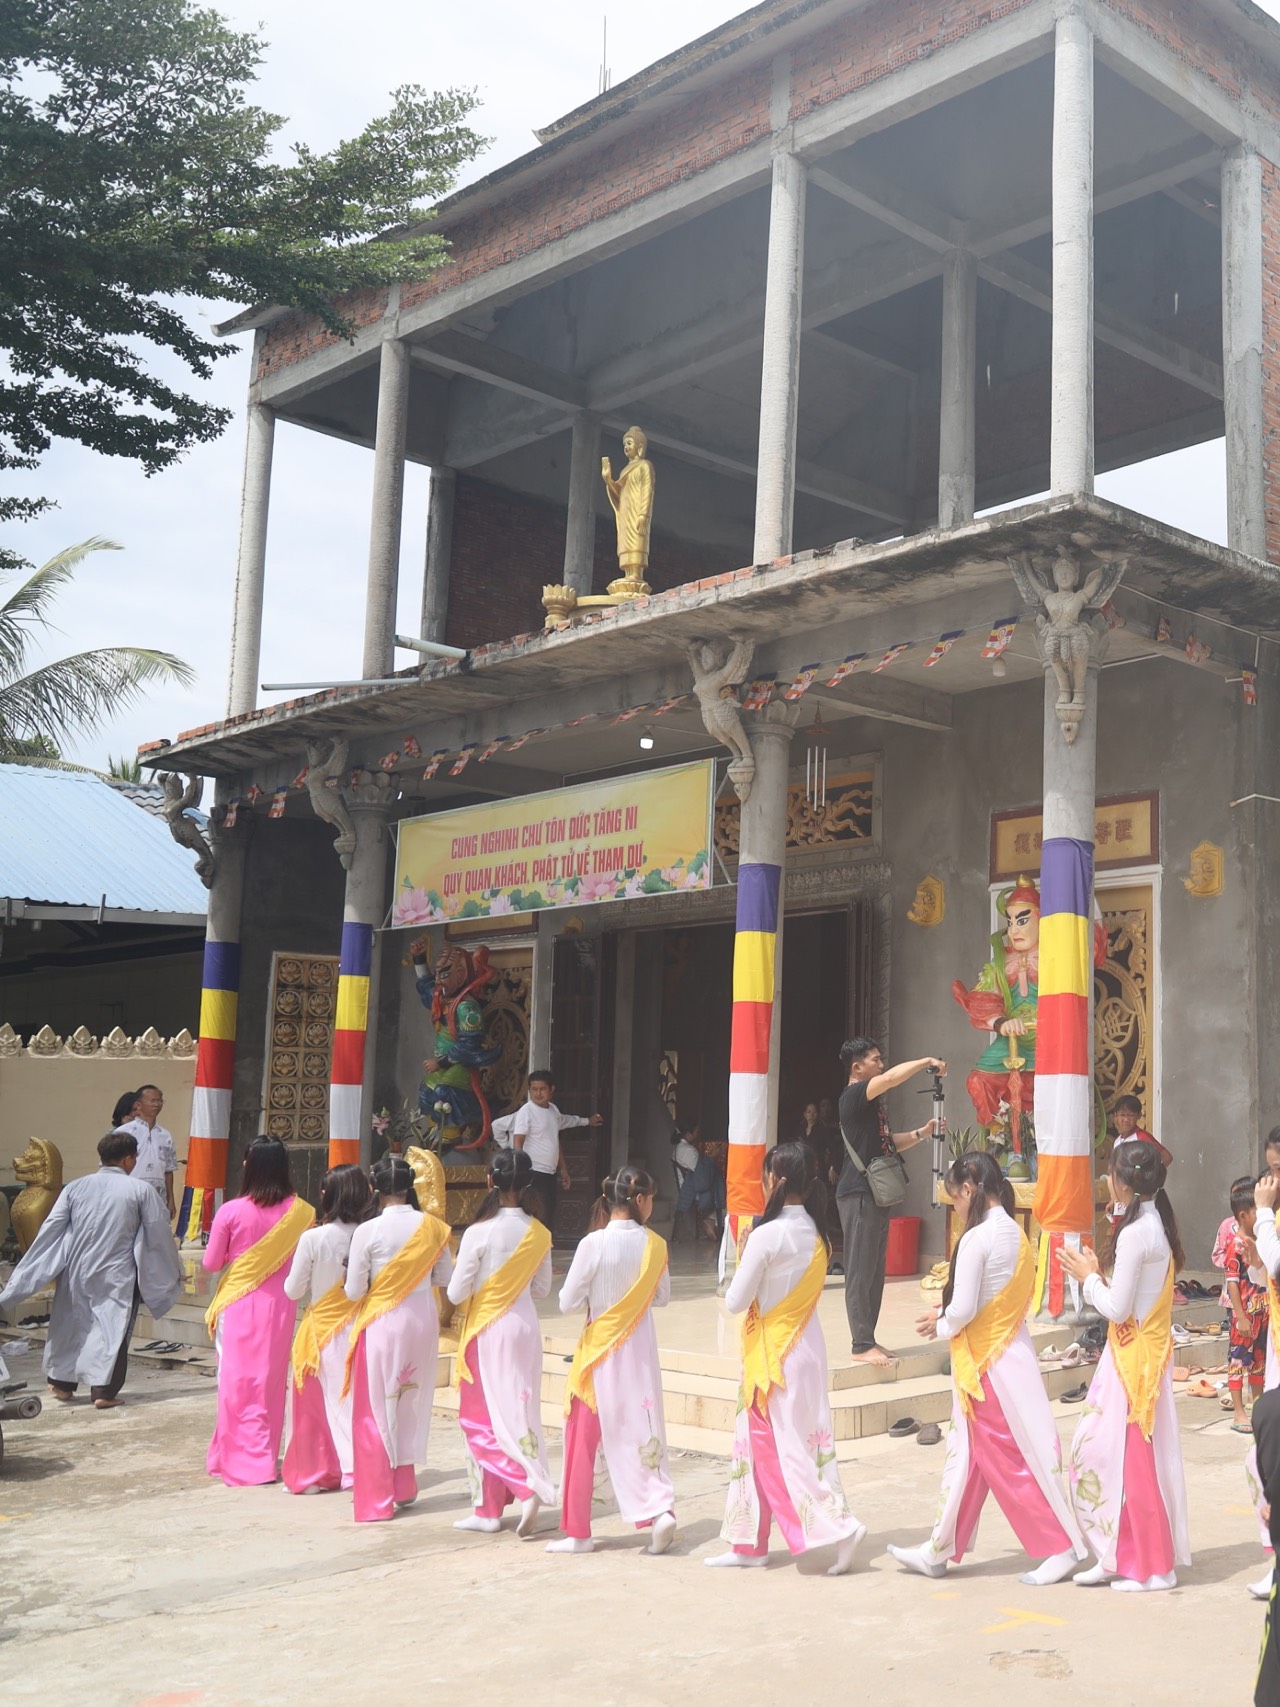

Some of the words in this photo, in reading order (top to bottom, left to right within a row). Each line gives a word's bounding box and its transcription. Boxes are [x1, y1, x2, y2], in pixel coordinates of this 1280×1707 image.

[451, 835, 478, 859] CUNG
[480, 827, 519, 855] NGHINH
[522, 820, 544, 848] CHƯ
[546, 816, 565, 844] TÔN
[569, 811, 590, 839] ĐỨC
[593, 807, 622, 835] TĂNG
[625, 805, 638, 831] NI
[443, 867, 462, 897] QUÝ
[465, 867, 492, 894] QUAN
[532, 854, 557, 886] PHẬT
[561, 846, 575, 878] TỬ
[577, 842, 591, 876] VỀ
[593, 846, 623, 874] THAM
[627, 840, 643, 873] DỰ
